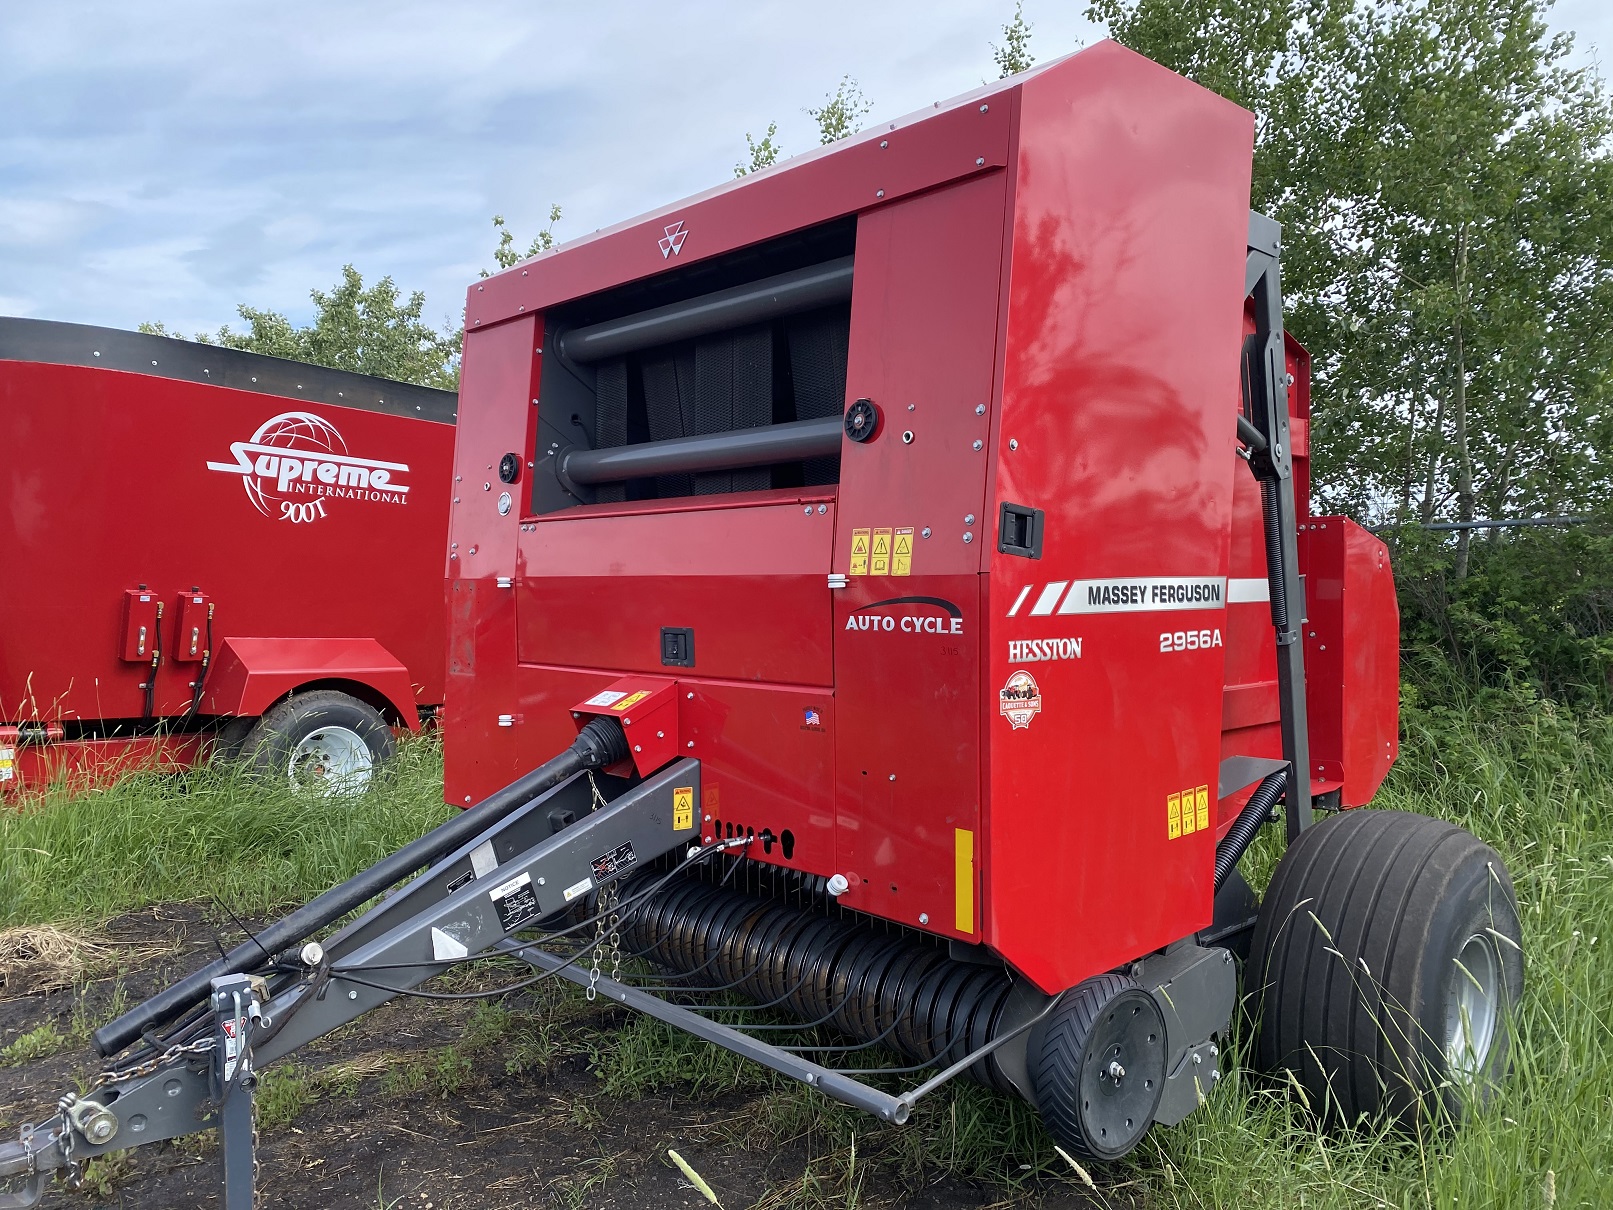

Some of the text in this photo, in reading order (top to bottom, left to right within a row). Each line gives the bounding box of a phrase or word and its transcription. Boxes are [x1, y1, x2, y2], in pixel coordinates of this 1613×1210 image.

[206, 442, 410, 493] Supreme
[288, 481, 408, 505] INTERNATIONAL
[278, 496, 328, 524] 900T
[1088, 584, 1220, 605] MASSEY FERGUSON
[845, 615, 964, 635] AUTO CYCLE
[1008, 637, 1083, 663] HESSTON
[1159, 628, 1223, 653] 2956A
